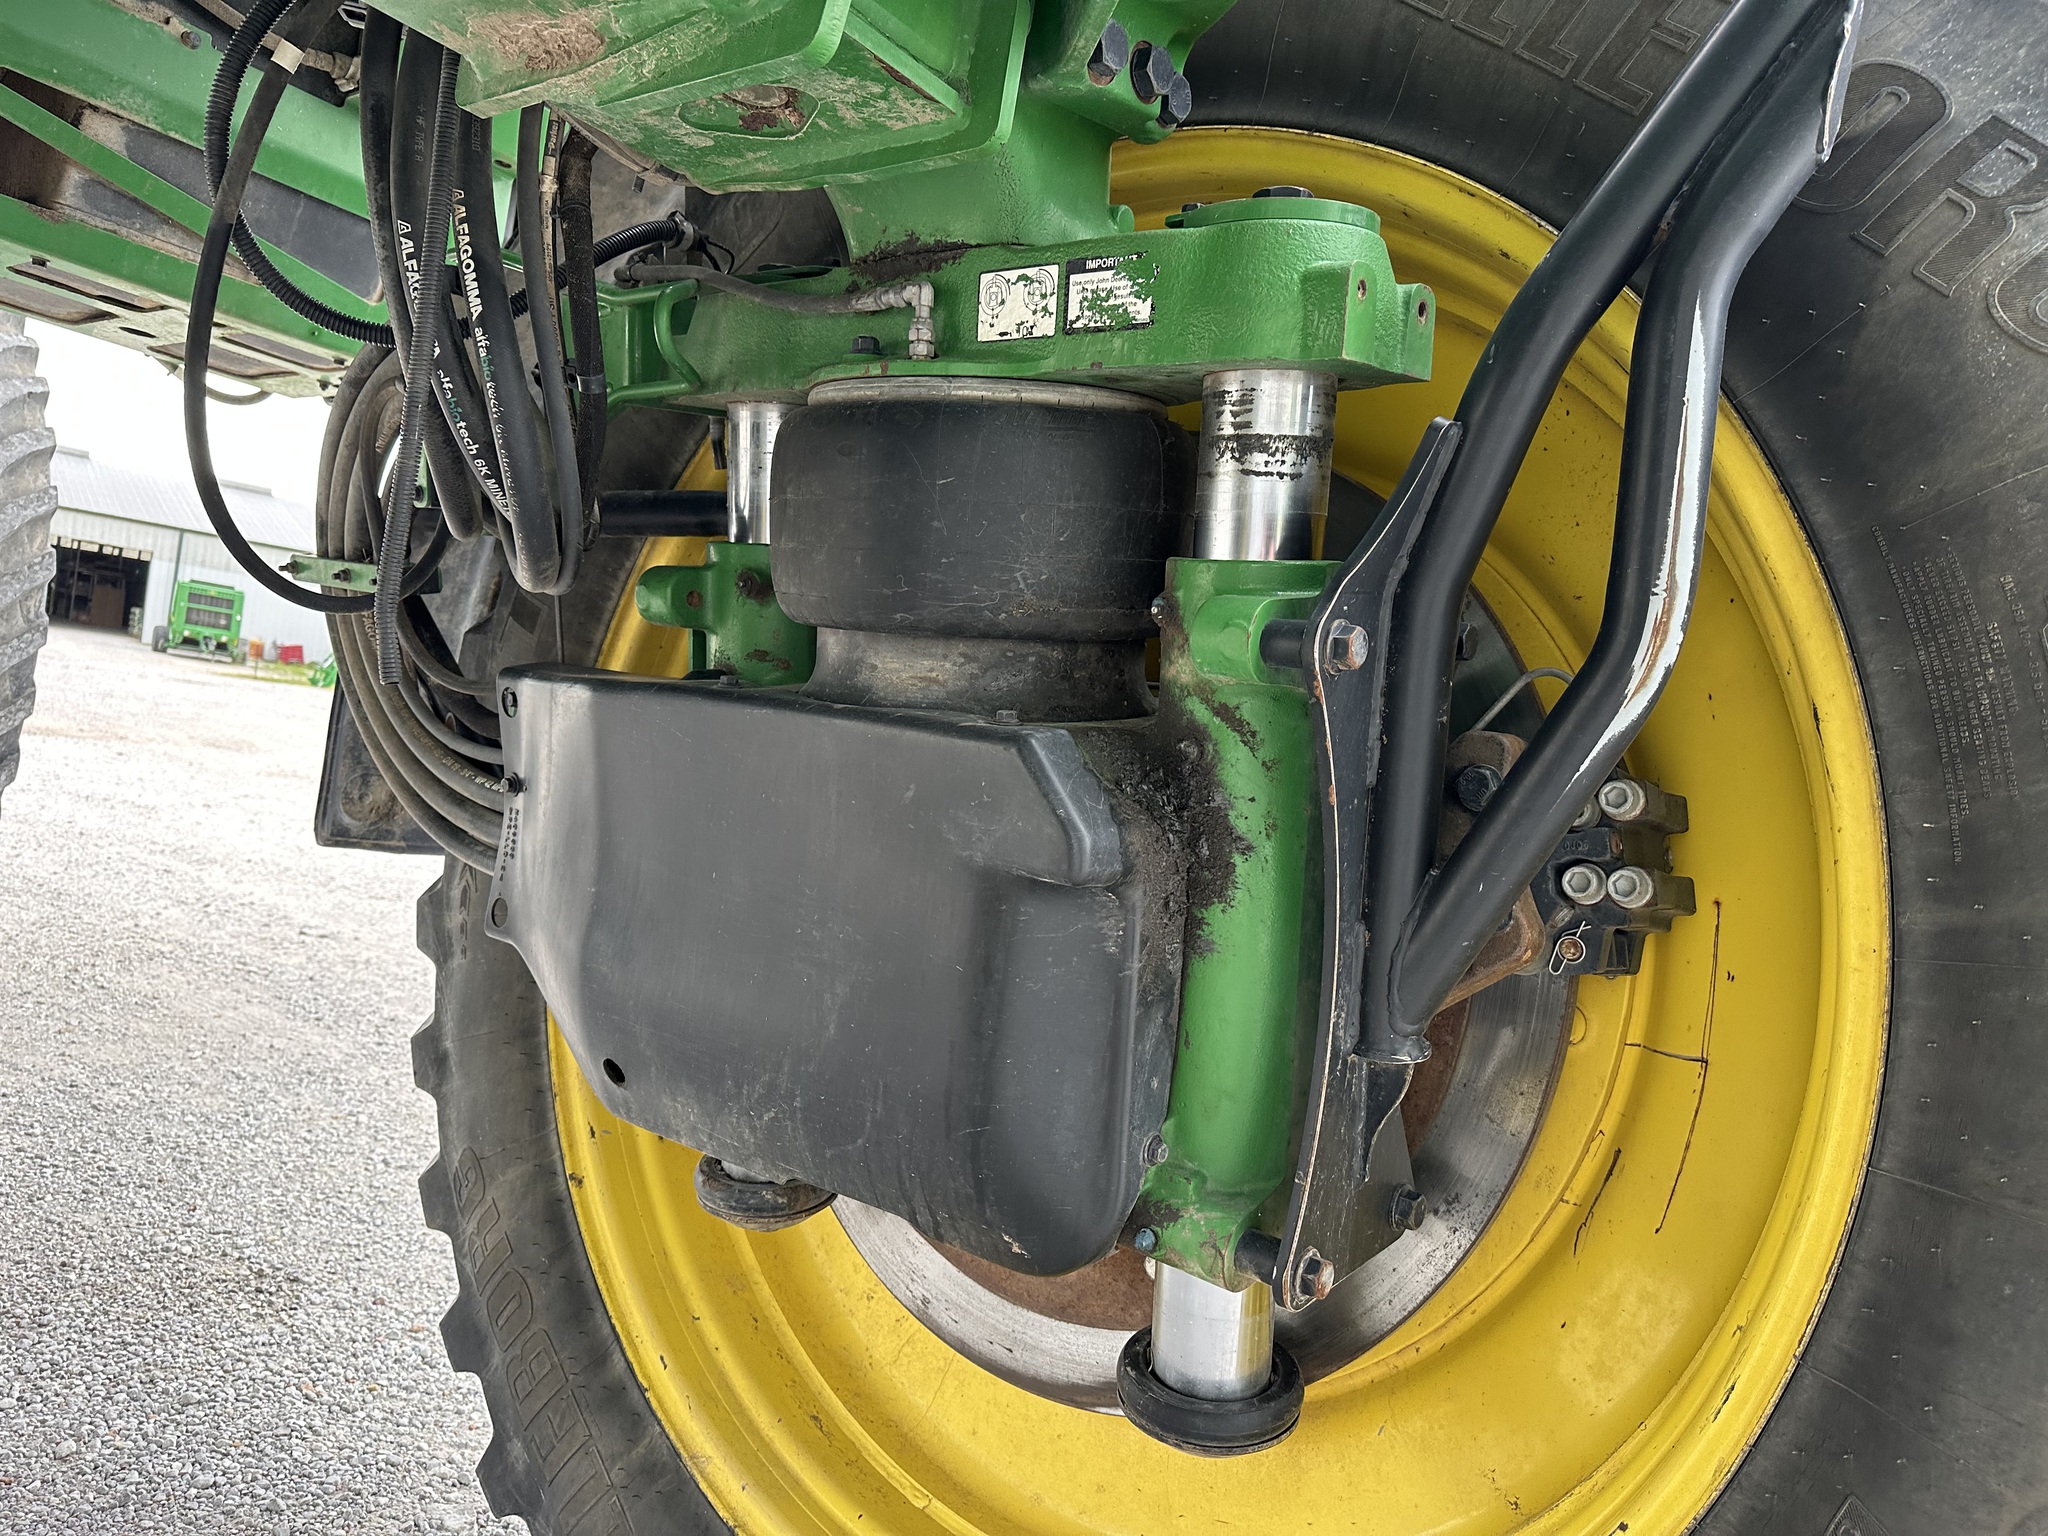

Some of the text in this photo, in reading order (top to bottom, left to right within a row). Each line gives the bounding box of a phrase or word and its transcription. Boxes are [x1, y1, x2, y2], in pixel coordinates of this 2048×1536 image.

[414, 131, 424, 151] TYPE
[547, 121, 558, 148] Parker
[452, 201, 481, 321] ALFAGOMMA
[1082, 278, 1094, 287] only
[1095, 276, 1109, 284] John
[373, 431, 391, 454] ITALY
[474, 458, 488, 478] 6K
[487, 475, 511, 517] MINET
[1901, 570, 1916, 591] ONLY
[1912, 565, 1928, 592] APPLY
[1910, 593, 1931, 638] SPECIALLY
[1922, 594, 1939, 626] RUBBER
[1933, 627, 1955, 673] LUBRICANT
[1945, 551, 1967, 587] SERIOUS
[1959, 588, 1982, 631] PERSONAL
[1973, 633, 1993, 665] INJURY
[1990, 687, 2003, 722] RESULT
[1997, 723, 2009, 749] FROM
[1953, 611, 1975, 653] ASSEMBLY
[1983, 620, 2007, 662] SAFETY
[2009, 602, 2026, 623] 350
[2026, 659, 2042, 680] 3.5
[1922, 561, 1940, 588] NEVER
[1933, 589, 1952, 622] EXCEED
[1949, 635, 1961, 650] PSI
[1956, 660, 1969, 678] 350
[1966, 700, 1978, 725] WHEN
[1972, 726, 1986, 767] SEATING
[1925, 640, 1944, 677] TRAINED
[1967, 655, 1981, 673] DUE
[1871, 526, 1962, 866] CONSULT MANUFACTURERS INSTRUCTIONS FOR ADDITIONAL SAFETY INFORMATION.
[1935, 678, 1952, 717] PERSONS
[1947, 675, 1958, 687] TO
[1974, 675, 1984, 688] TO
[1951, 689, 1963, 712] BOTH
[1977, 689, 1992, 733] IMPROPER
[1945, 719, 1960, 755] SHOULD
[1952, 756, 1964, 787] MOUNT
